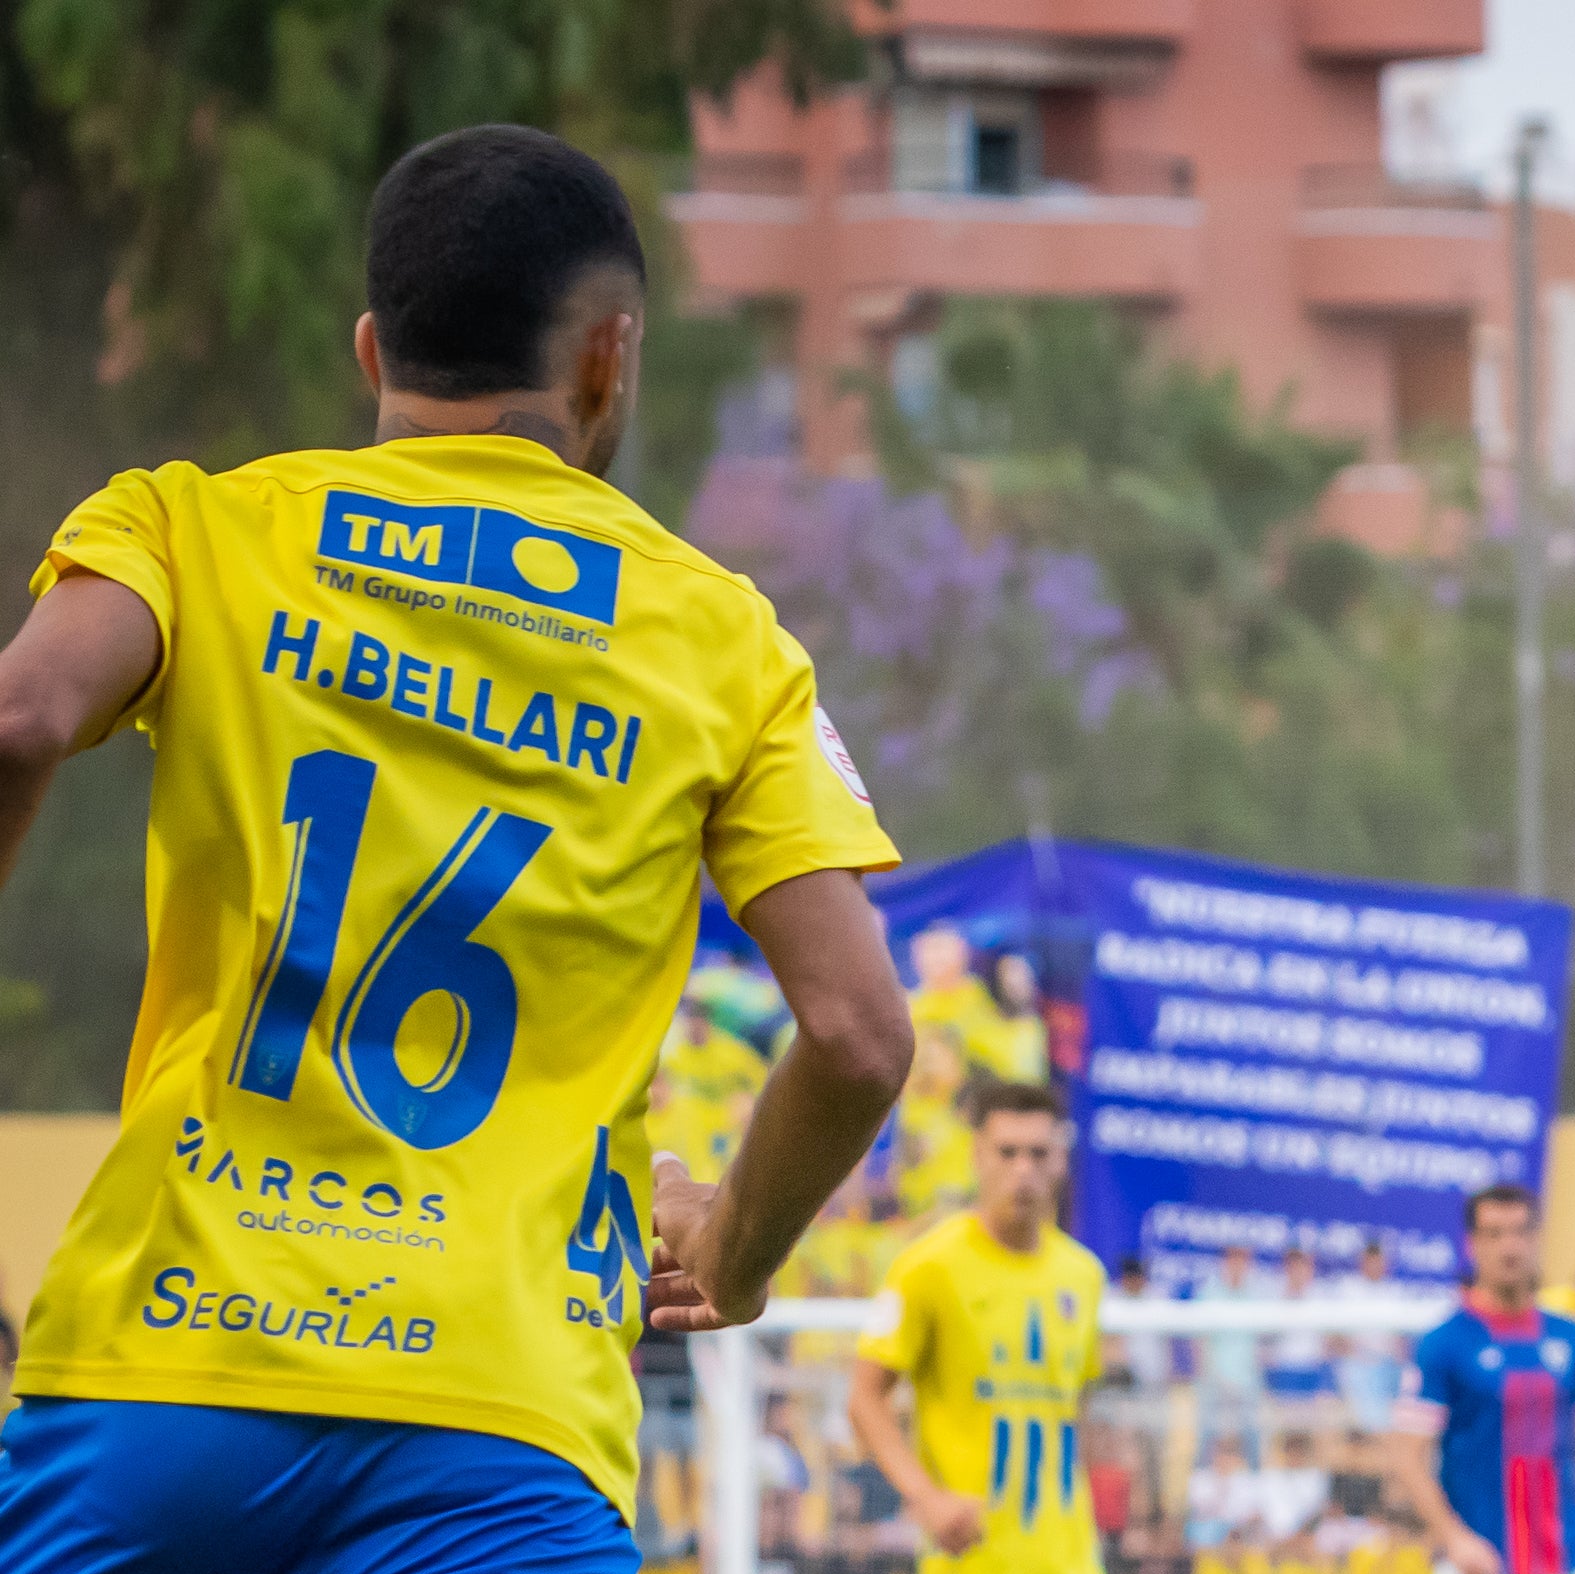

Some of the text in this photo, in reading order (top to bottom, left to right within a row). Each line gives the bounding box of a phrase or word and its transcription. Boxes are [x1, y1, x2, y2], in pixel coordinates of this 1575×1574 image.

[341, 512, 443, 566] TM
[313, 564, 610, 652] TM Grupo Inmobiliario
[262, 609, 641, 785] H.BELLARI
[228, 748, 552, 1151] 16
[175, 1116, 447, 1222] MARCOS
[237, 1210, 445, 1253] automoción
